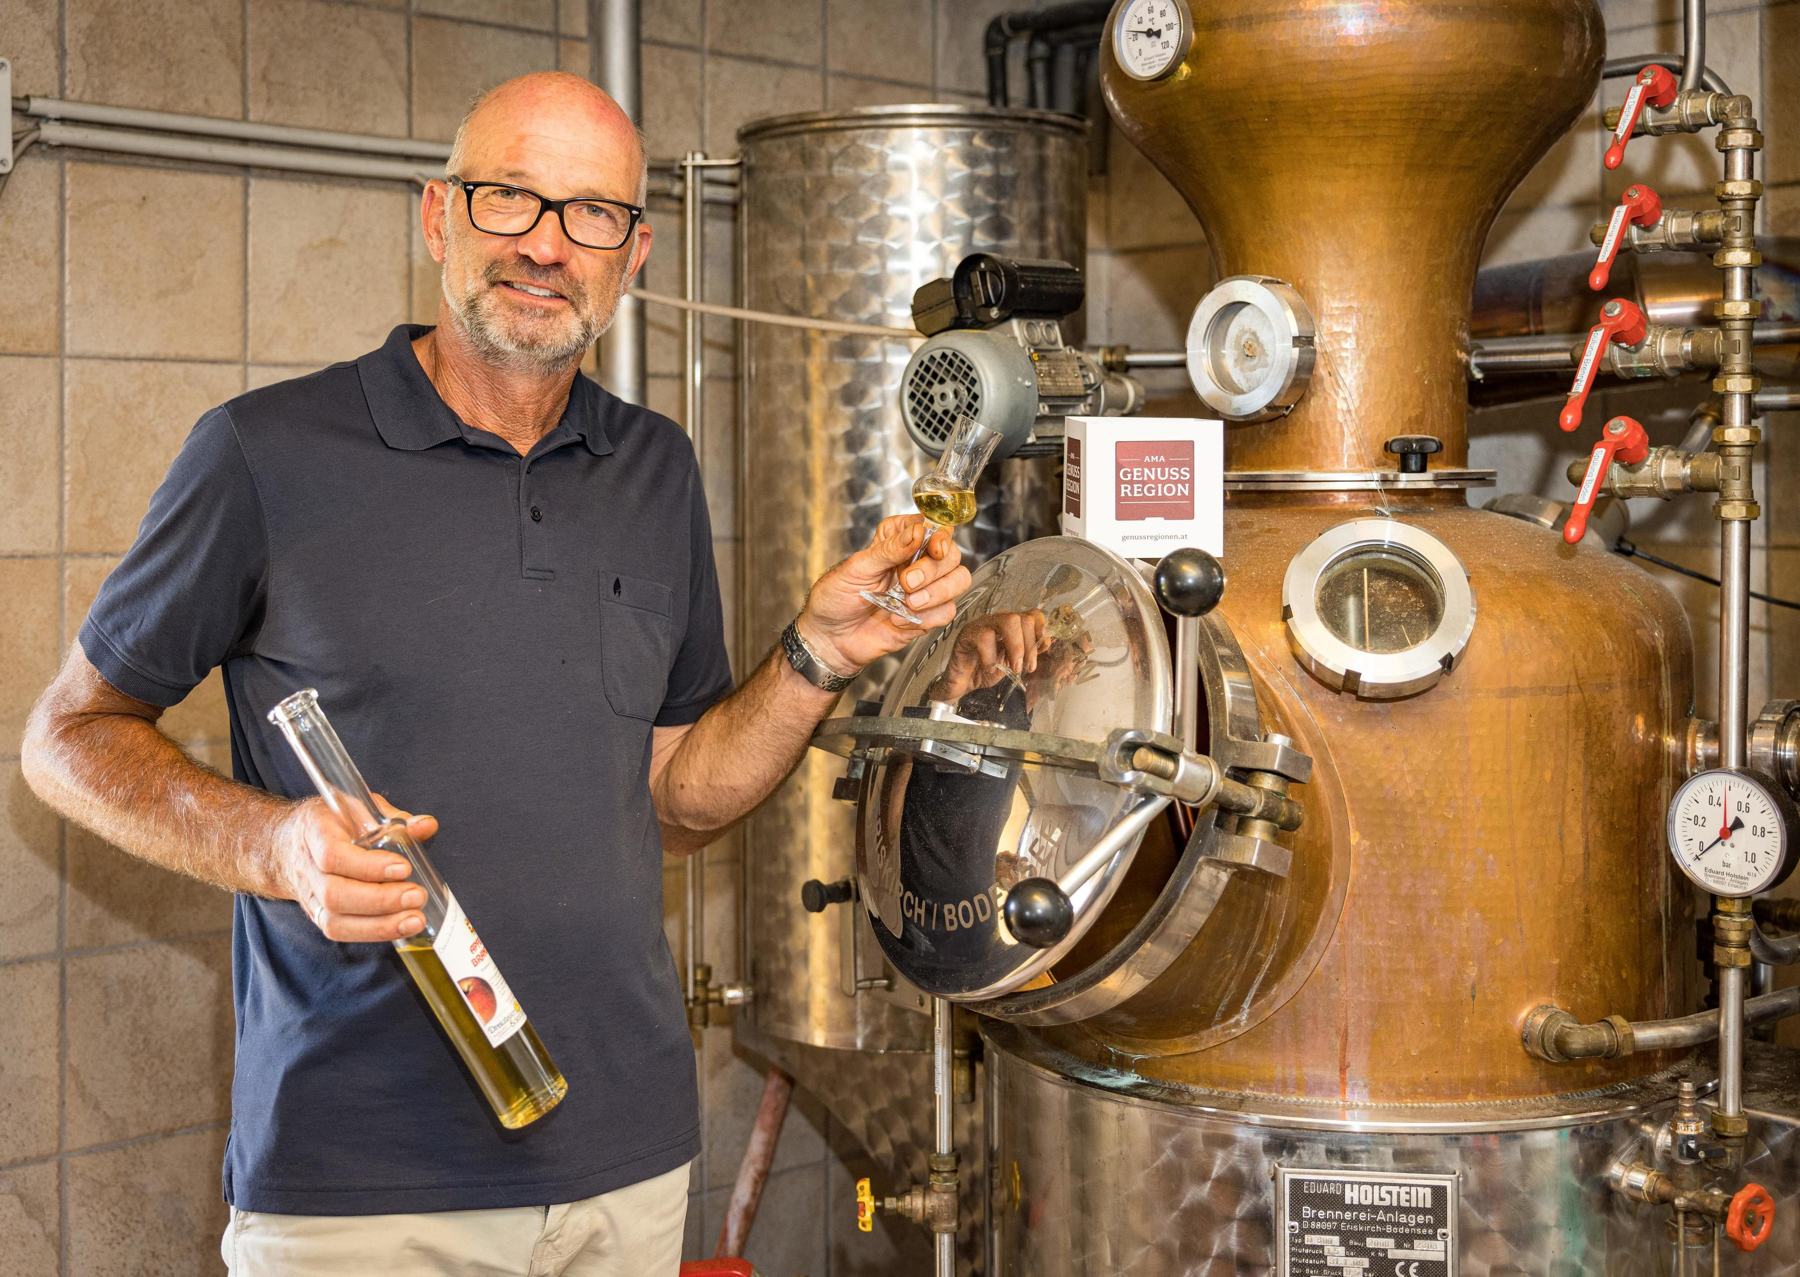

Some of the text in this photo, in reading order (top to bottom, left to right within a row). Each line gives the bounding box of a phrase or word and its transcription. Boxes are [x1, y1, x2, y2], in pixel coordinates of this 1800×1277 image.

[1144, 455, 1165, 463] AMA
[1119, 467, 1191, 481] GENUSS
[1120, 483, 1190, 497] REGION
[1121, 533, 1188, 542] genussregionen.at
[1736, 801, 1750, 814] 0.6
[1693, 815, 1706, 828] 0.2
[1752, 825, 1766, 838] 0.8
[1698, 841, 1704, 852] 0
[1744, 851, 1756, 864] 1.0
[1704, 866, 1725, 877] Eduard
[1303, 1181, 1432, 1208] EDUARD HOLSTEIN
[1302, 1206, 1434, 1226] Brennerei-Anlagen
[1310, 1221, 1337, 1230] 88097
